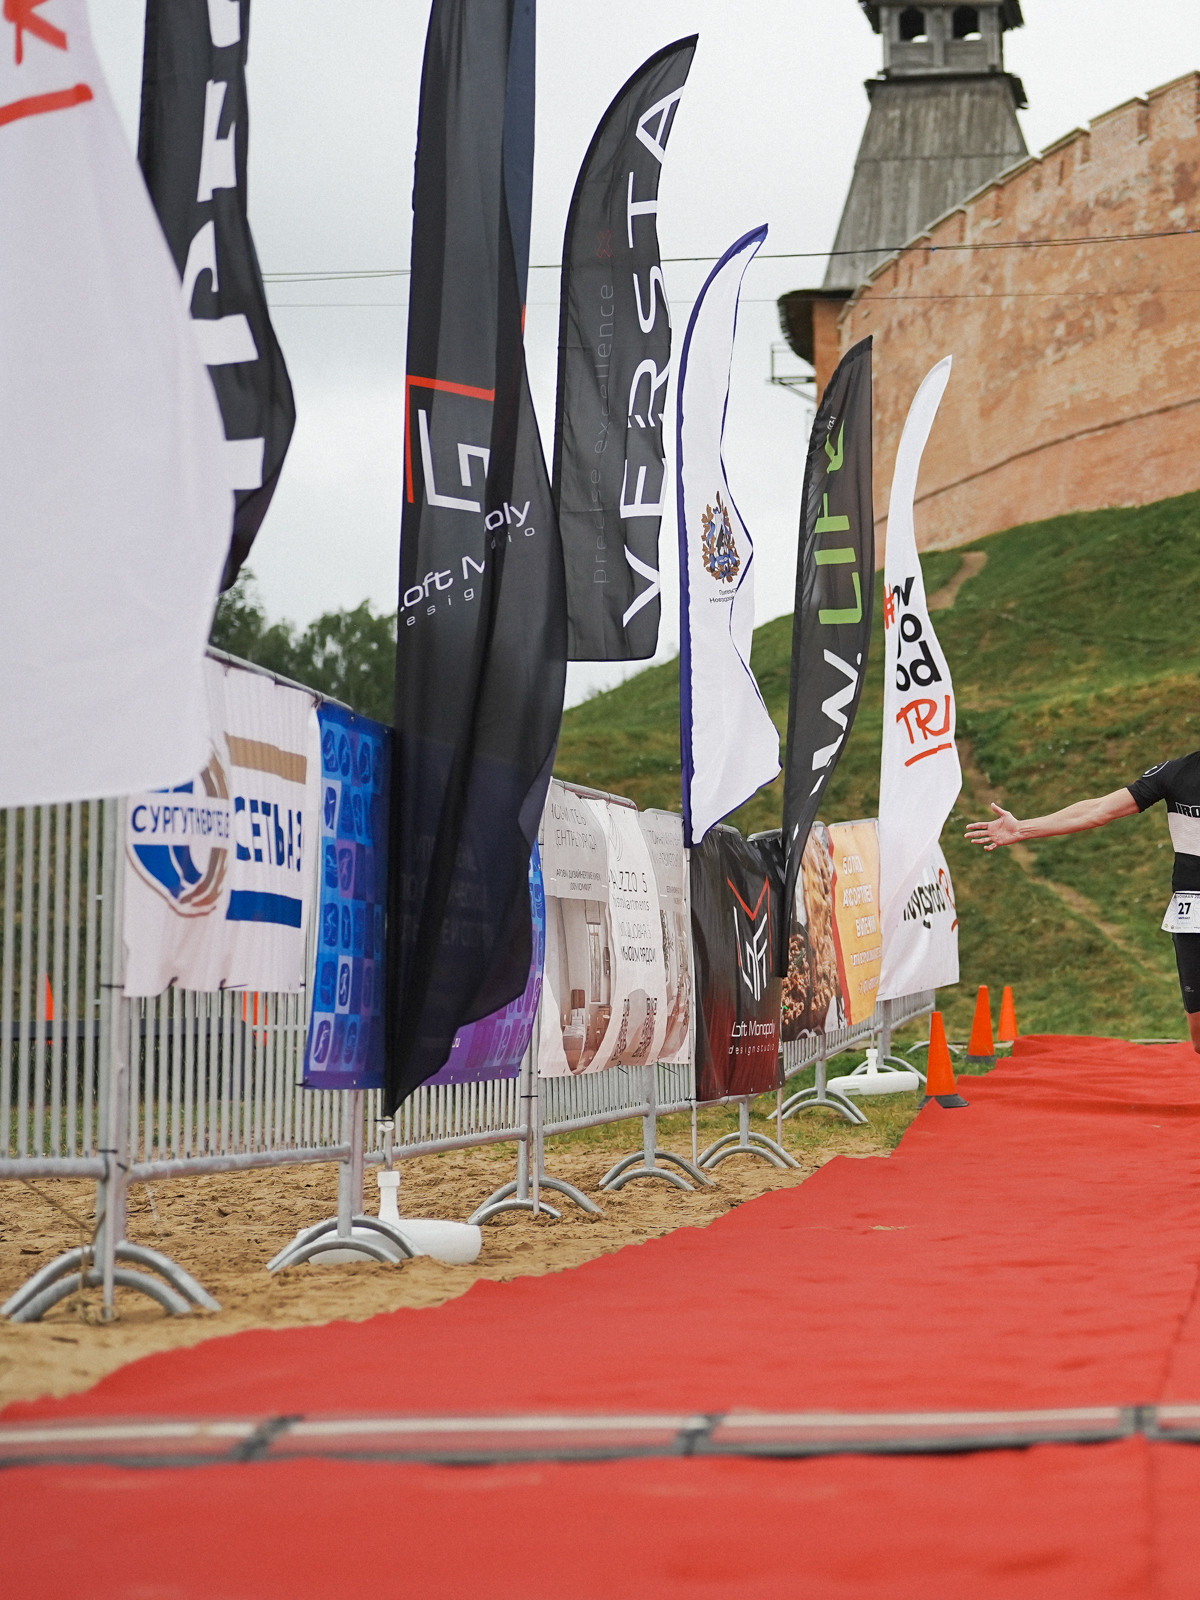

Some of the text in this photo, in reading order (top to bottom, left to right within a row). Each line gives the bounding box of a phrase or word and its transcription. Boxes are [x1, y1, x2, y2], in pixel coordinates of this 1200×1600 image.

[618, 86, 685, 628] VERSTA
[400, 568, 454, 613] oft
[1177, 902, 1192, 915] 27
